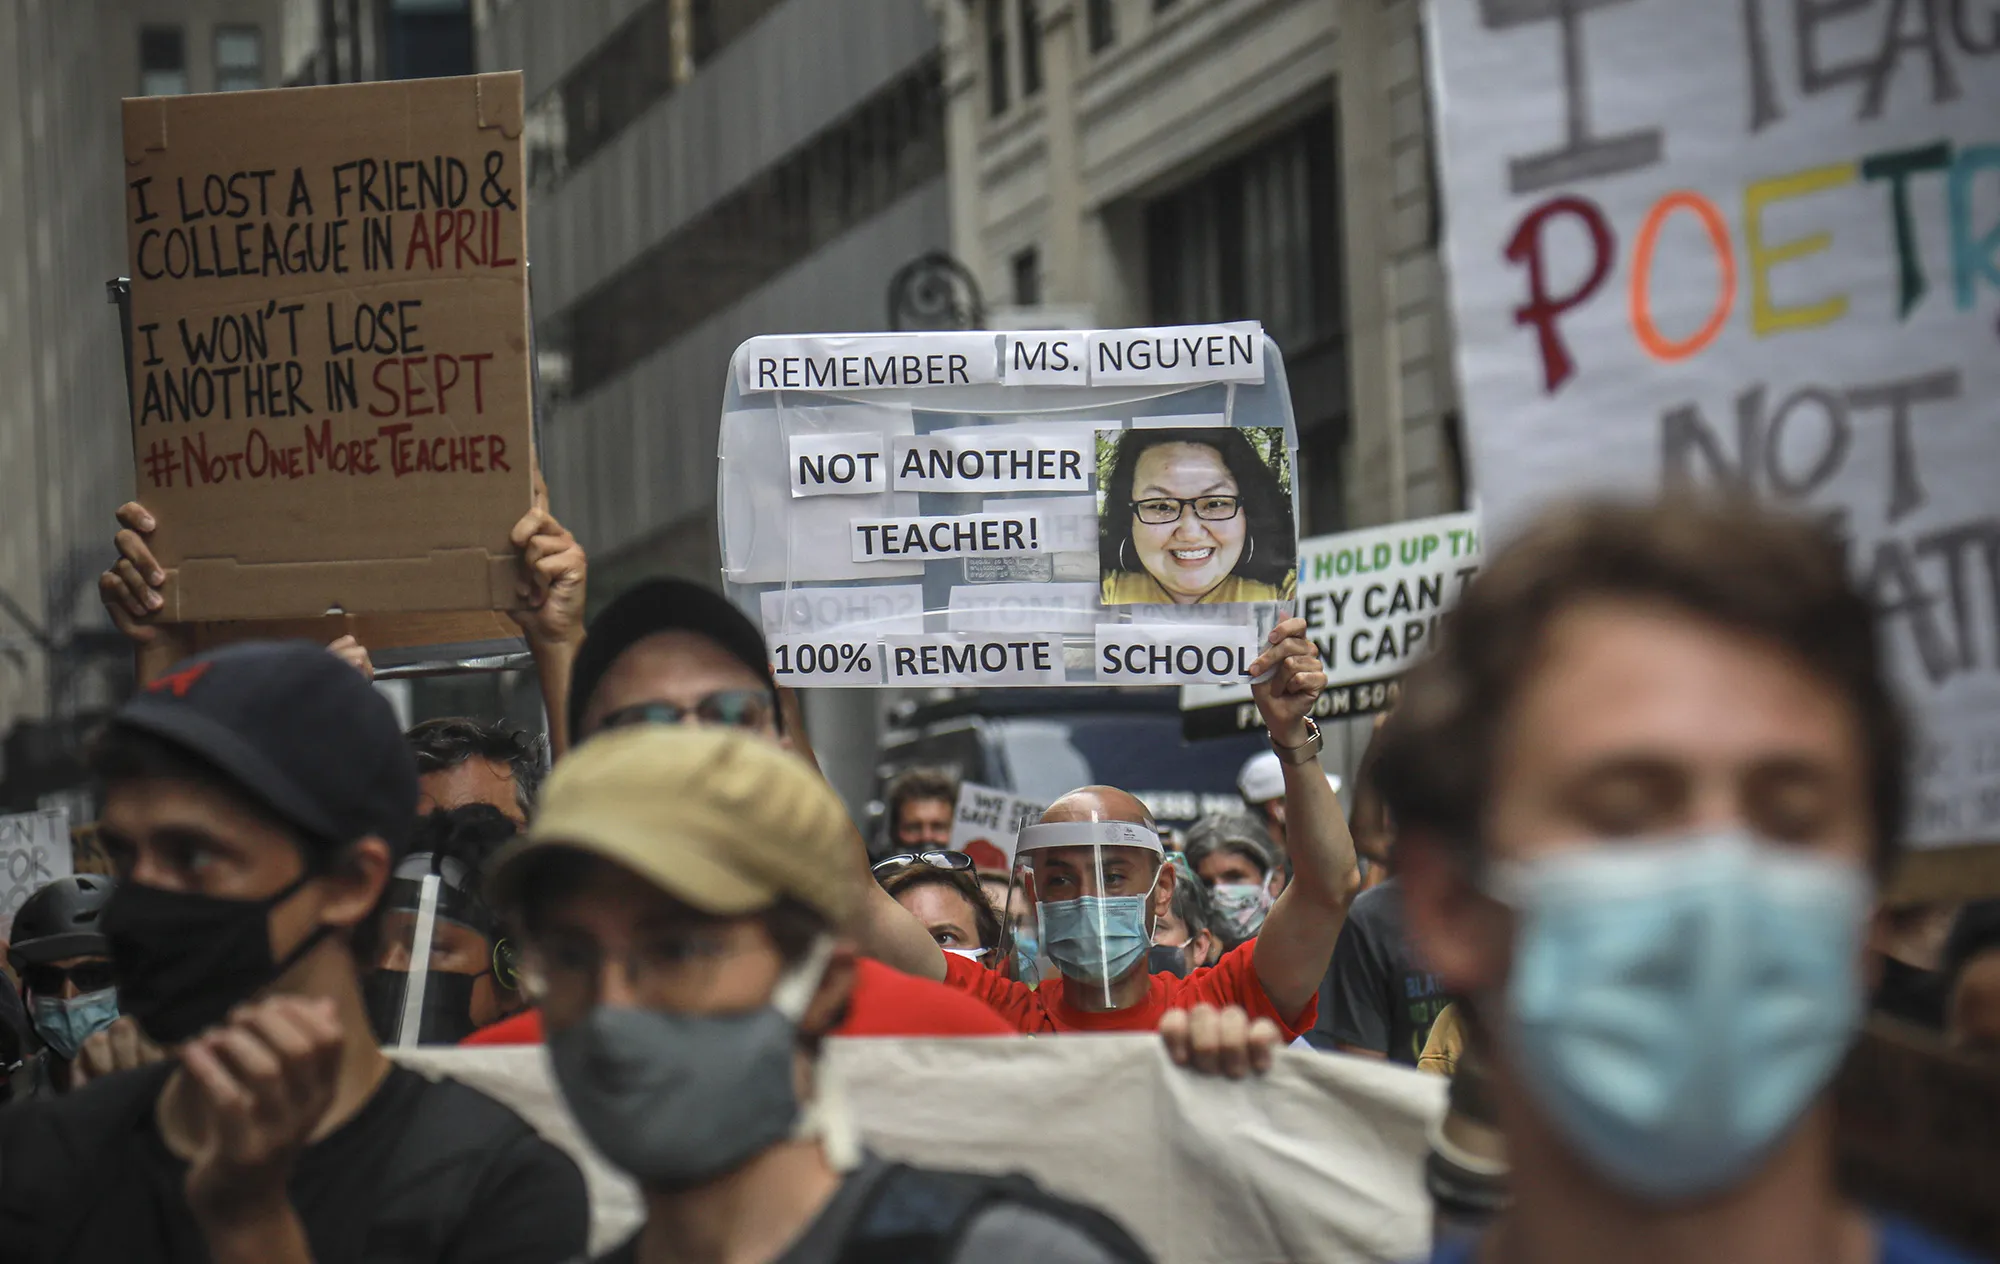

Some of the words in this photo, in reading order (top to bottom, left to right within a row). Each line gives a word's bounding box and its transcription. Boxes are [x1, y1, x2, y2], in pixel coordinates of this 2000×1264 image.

[130, 176, 158, 224] I
[177, 169, 276, 223] LOST
[287, 167, 313, 217] A
[333, 155, 468, 217] FRIEND
[480, 150, 517, 211] &
[136, 218, 350, 281] COLLEAGUE
[363, 214, 394, 271] IN
[405, 208, 517, 271] APRIL
[1503, 138, 2000, 396] POETR
[138, 322, 165, 367] I
[178, 300, 305, 366] WON'T
[327, 300, 424, 356] LOSE
[758, 354, 969, 389] REMEMBER
[1013, 341, 1079, 373] MS.
[1098, 334, 1254, 372] NGUYEN
[141, 360, 314, 426] ANOTHER
[325, 358, 359, 412] IN
[368, 352, 494, 418] SEPT
[798, 452, 880, 485] NOT
[900, 449, 1082, 481] ANOTHER
[1660, 367, 1962, 524] NOT
[856, 517, 1038, 556] TEACHER!
[1314, 542, 1392, 581] HOLD
[1400, 534, 1440, 565] UP
[1364, 573, 1443, 620] CAN
[775, 643, 872, 674] 100%
[894, 641, 1052, 677] REMOTE
[1103, 644, 1250, 676] SCHOOL
